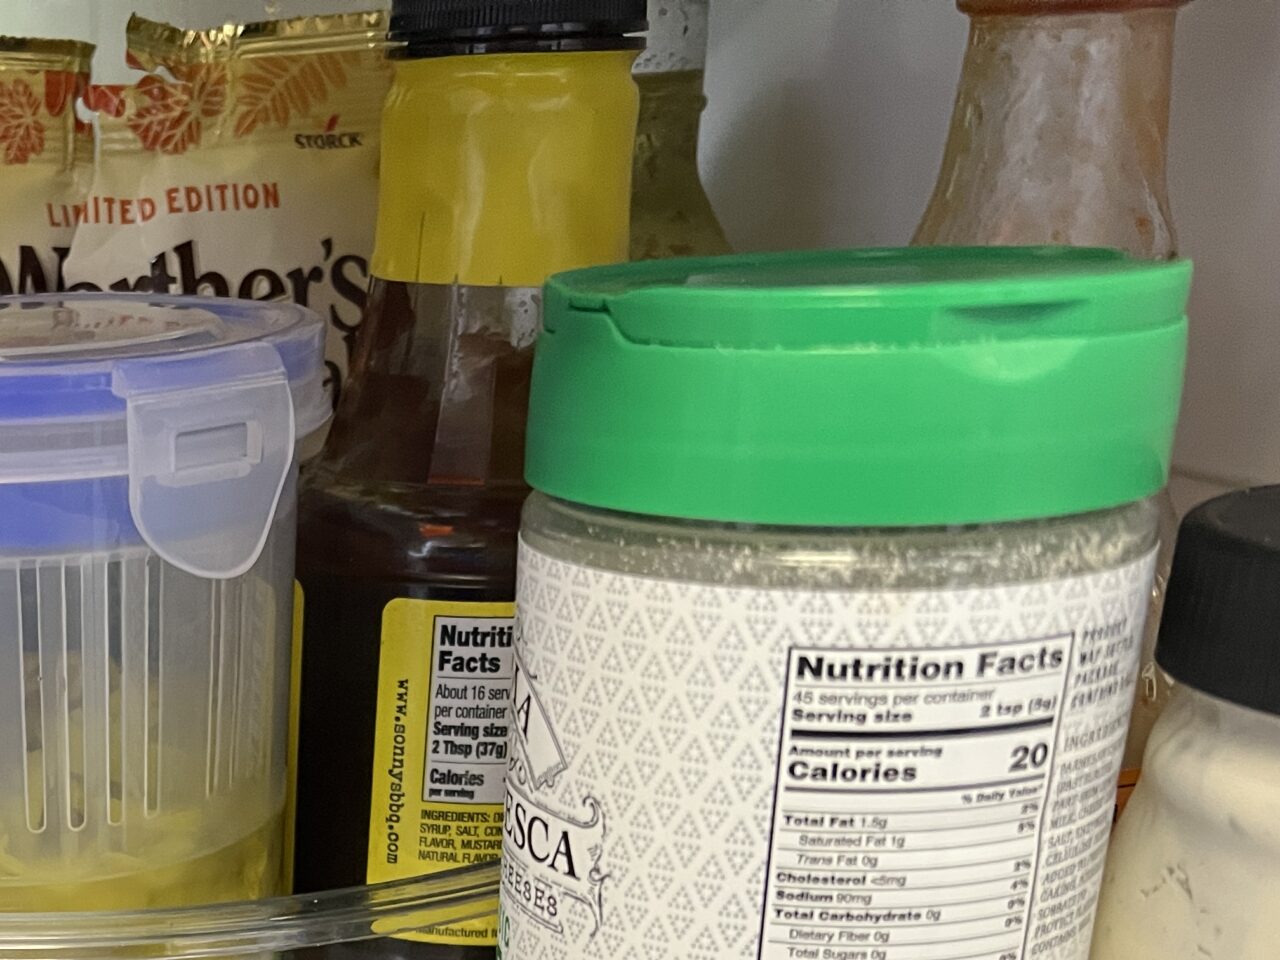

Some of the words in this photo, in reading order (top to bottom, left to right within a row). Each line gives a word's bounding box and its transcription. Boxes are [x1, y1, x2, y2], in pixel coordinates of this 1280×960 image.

[294, 132, 364, 149] STORCK
[47, 197, 157, 227] LIMITED
[166, 182, 280, 214] EDITION
[440, 624, 513, 648] Nutriti
[438, 651, 501, 673] Facts
[796, 656, 965, 681] Nutrition
[975, 648, 1064, 677] Facts
[435, 684, 468, 700] About
[471, 685, 485, 700] 16
[488, 687, 511, 700] serv
[793, 690, 814, 705] 45
[819, 690, 888, 708] servings
[893, 693, 918, 707] per
[923, 688, 995, 705] container
[434, 704, 453, 720] per
[455, 704, 508, 719] container
[791, 708, 867, 724] Serving
[873, 709, 913, 722] size
[996, 701, 1023, 718] tsp
[433, 721, 479, 740] Serving
[482, 723, 508, 737] size
[431, 740, 440, 754] 2
[443, 740, 472, 758] Tbsp
[475, 741, 508, 759] (37g)
[788, 745, 851, 758] Amount
[855, 747, 881, 761] per
[885, 746, 943, 759] serving
[788, 761, 917, 783] Calories
[1008, 742, 1049, 773] 20
[386, 678, 409, 865] www.sonnysbbq.com
[429, 768, 484, 786] Calories
[421, 809, 490, 823] INGREDIENTS:
[783, 814, 825, 826] Total
[828, 816, 855, 828] Fat
[860, 817, 888, 830] 1.5g
[420, 823, 452, 837] SYRUP,
[456, 825, 480, 838] SALT,
[419, 836, 457, 850] FLAVOR,
[460, 840, 503, 850] MUSTAR
[798, 834, 862, 847] Saturated
[865, 836, 887, 847] Fat
[890, 836, 906, 849] 1g
[417, 850, 461, 863] NATURAL
[796, 853, 834, 865] Trans
[836, 854, 858, 866] Fat
[861, 854, 879, 868] 0g
[775, 872, 867, 885] Cholesterol
[870, 875, 907, 889] <5mg
[775, 890, 834, 902] Sodium
[836, 892, 873, 905] 90mg
[773, 909, 814, 920] Total
[820, 910, 922, 924] Carbohydrate
[925, 909, 941, 921] 0g
[788, 928, 834, 942] Dietary
[837, 929, 871, 941] Fiber
[873, 930, 890, 943] 0g
[787, 946, 821, 959] Total
[822, 948, 868, 960] Sugars
[870, 948, 887, 960] 0g
